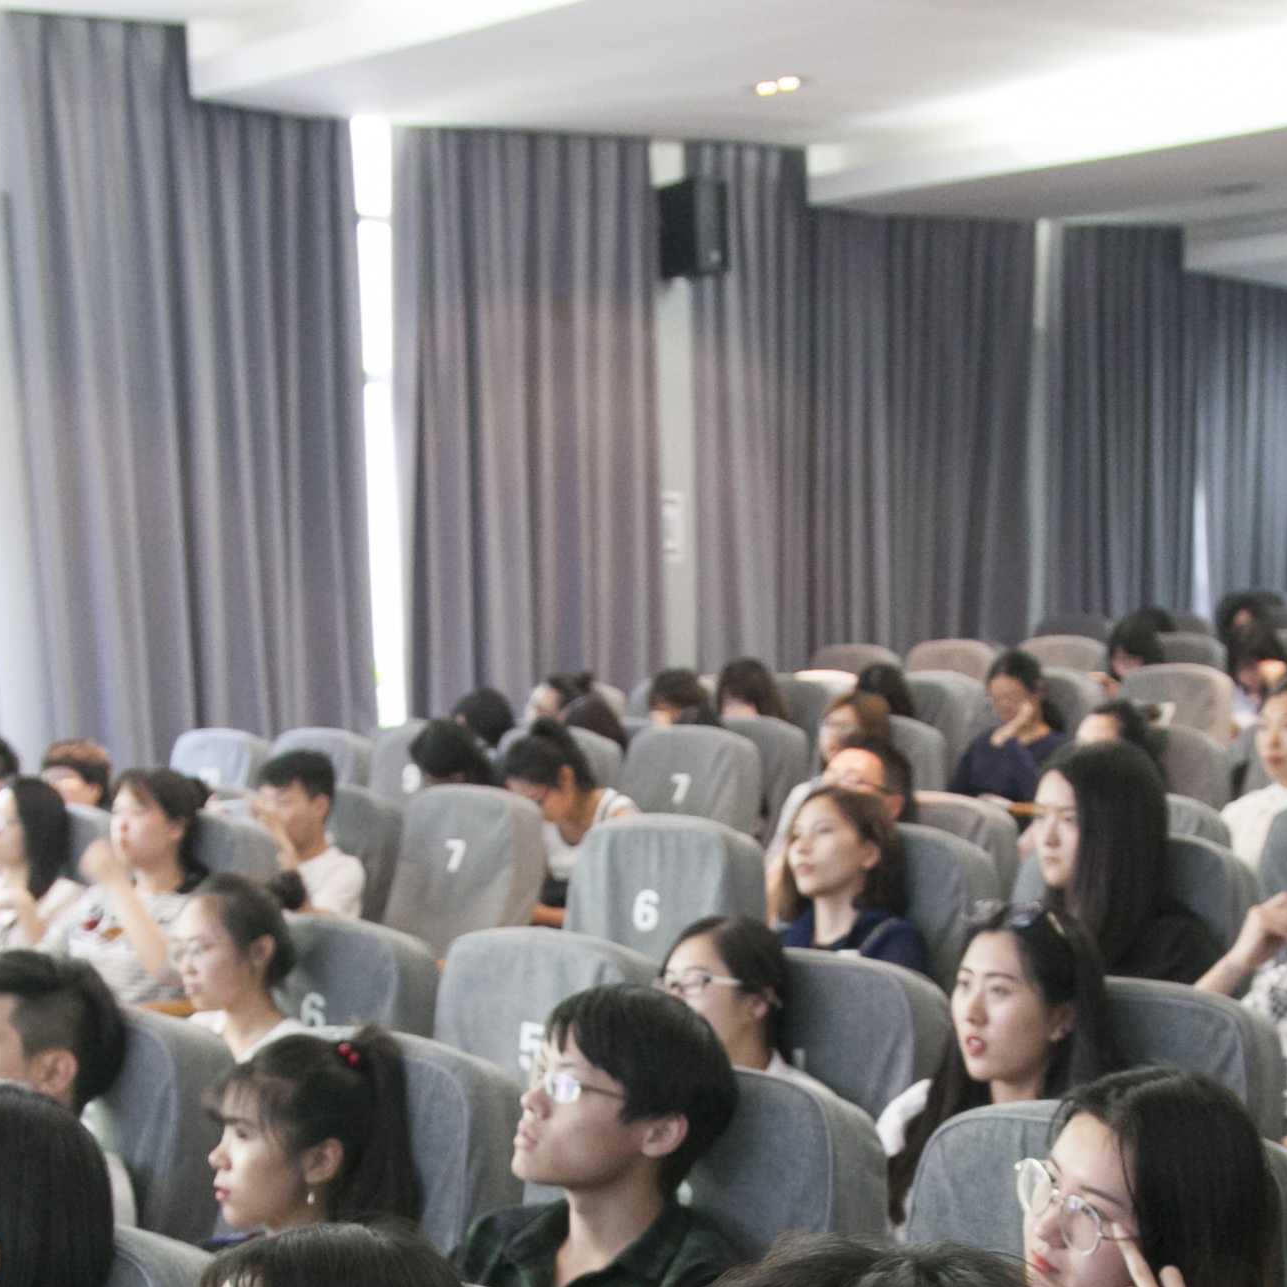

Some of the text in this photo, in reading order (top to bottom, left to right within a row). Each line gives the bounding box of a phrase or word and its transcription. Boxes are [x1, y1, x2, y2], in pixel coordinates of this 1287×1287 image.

[671, 772, 692, 806] 7
[445, 838, 467, 874] 7
[632, 888, 660, 933] 6
[300, 991, 328, 1028] 6
[518, 1020, 545, 1072] 5
